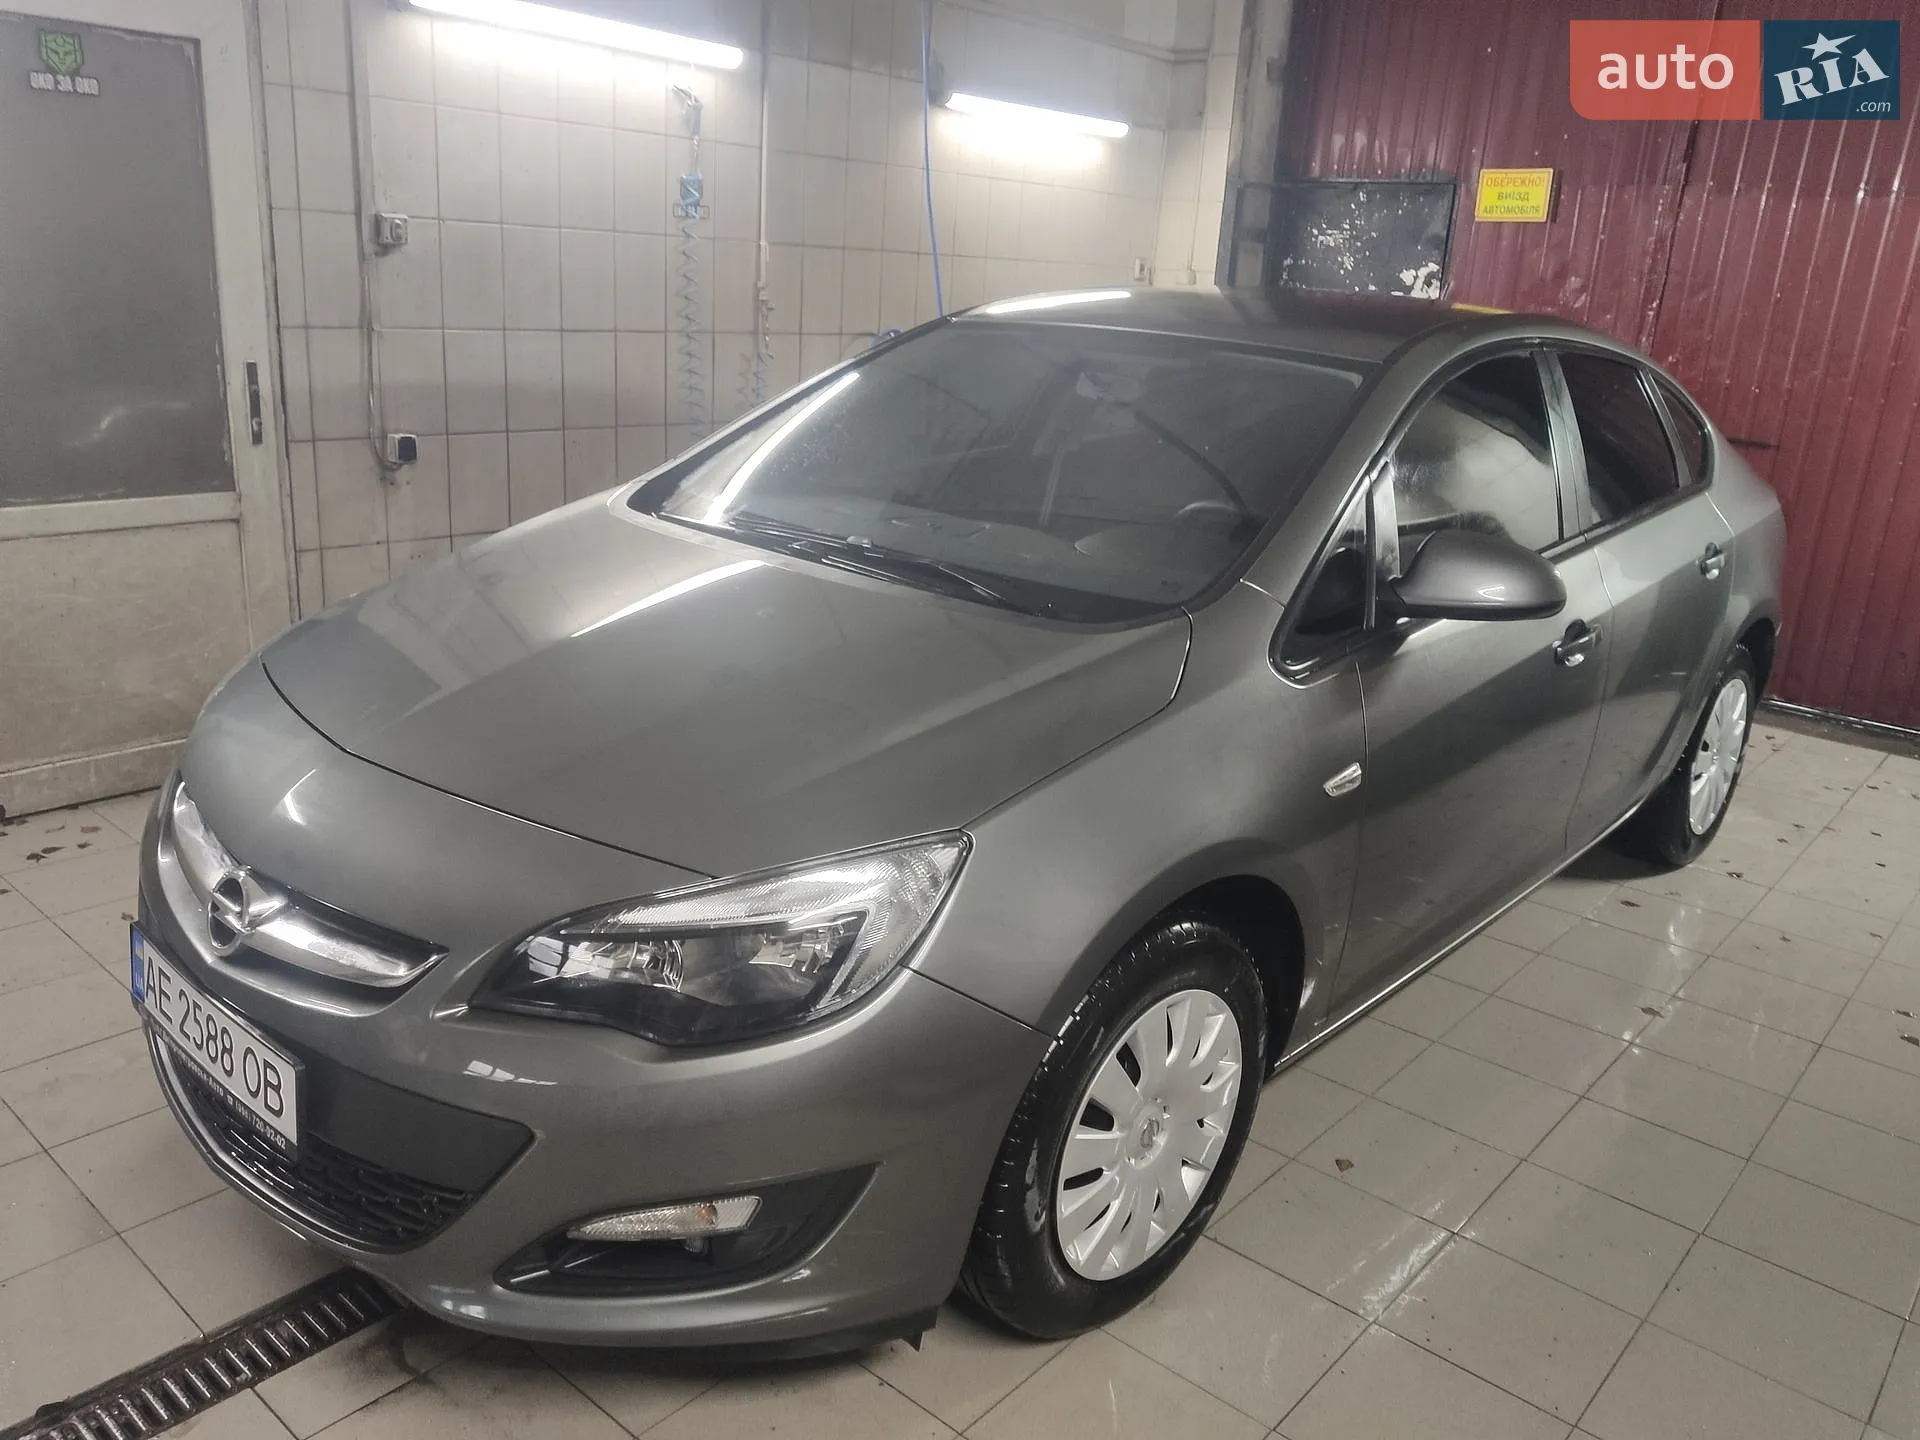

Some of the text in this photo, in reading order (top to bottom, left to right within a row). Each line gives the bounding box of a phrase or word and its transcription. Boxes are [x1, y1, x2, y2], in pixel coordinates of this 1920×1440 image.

[146, 957, 172, 1024] AE
[179, 989, 235, 1078] 2588
[243, 1046, 284, 1118] OB
